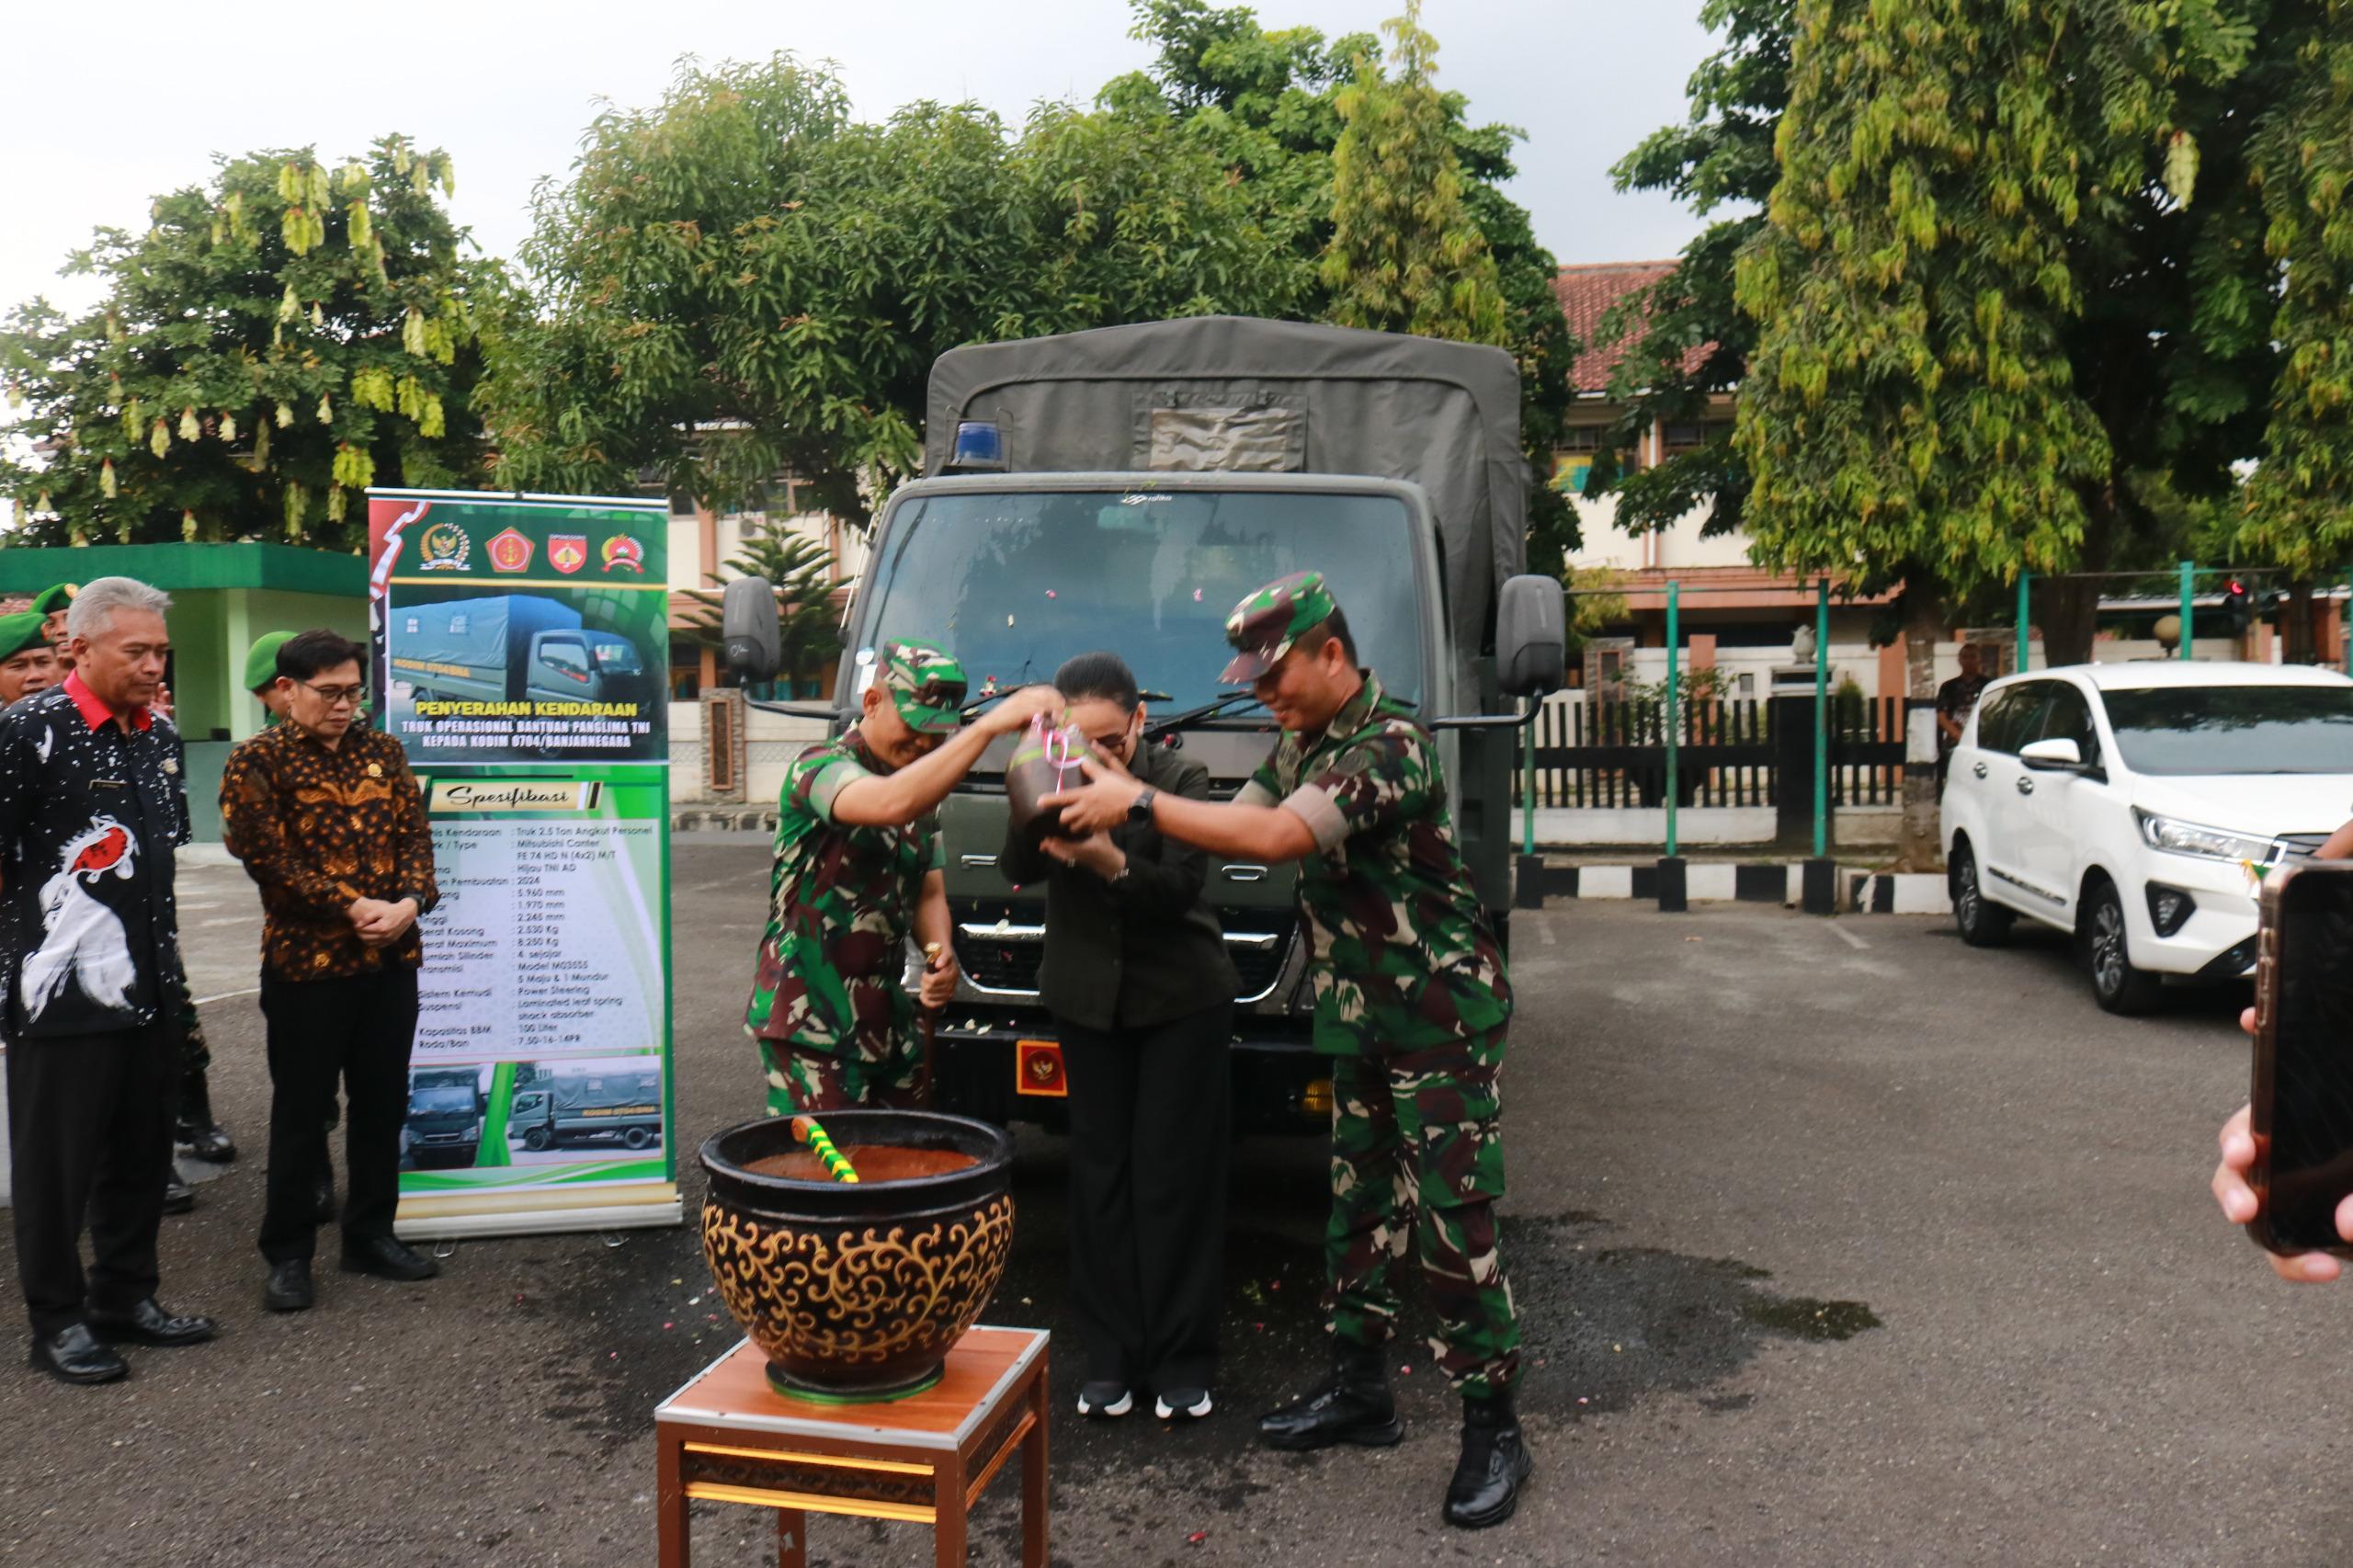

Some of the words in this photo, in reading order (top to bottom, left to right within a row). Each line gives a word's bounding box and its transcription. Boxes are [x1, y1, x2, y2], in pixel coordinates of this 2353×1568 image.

[415, 701, 531, 716] PENYERAHAN
[535, 701, 638, 717] KENDARAAN
[402, 720, 433, 733] TRUK
[436, 720, 515, 733] OPERASIONAL
[517, 721, 569, 733] BANTUAN
[572, 721, 629, 733] PANGLIMA
[631, 722, 651, 734] TNI
[422, 734, 467, 748] KEPADA
[470, 734, 508, 748] KODIM
[511, 734, 631, 748] 0704/BANJARNEGARA
[446, 786, 570, 808] Spesifikasi
[446, 828, 501, 836] Kendaraan
[517, 827, 535, 835] Truk
[556, 827, 573, 835] Ton
[574, 826, 609, 837] Angkut
[612, 826, 653, 835] Personel
[454, 841, 477, 851] Type
[517, 839, 564, 847] Mitsubishi
[517, 864, 541, 874] Hijau
[451, 878, 508, 886] Pembuatan
[448, 927, 484, 937] Kosong
[422, 952, 454, 960] umlah
[517, 962, 550, 971] Model
[517, 987, 548, 995] Power
